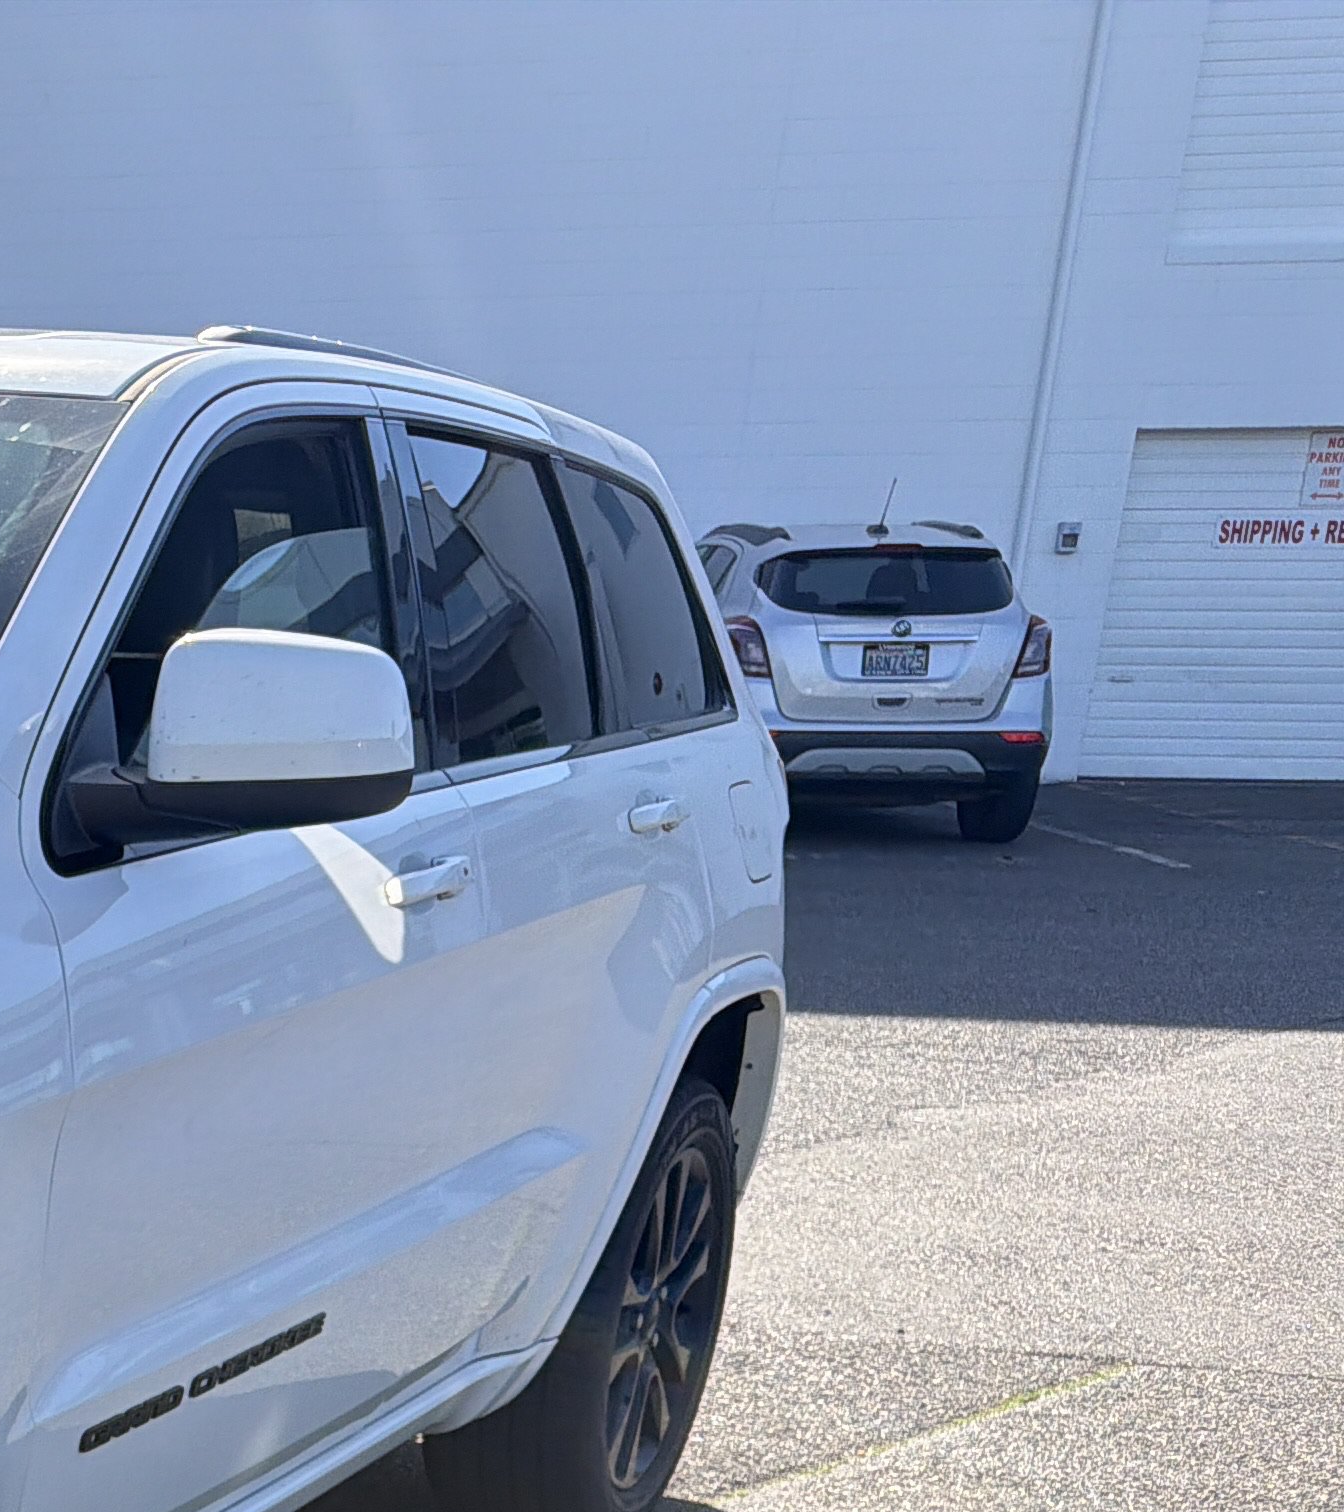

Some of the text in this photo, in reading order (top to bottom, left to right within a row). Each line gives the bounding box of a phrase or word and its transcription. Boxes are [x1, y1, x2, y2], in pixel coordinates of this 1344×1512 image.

[1327, 437, 1344, 449] NO
[1309, 451, 1344, 464] PARKI
[1321, 466, 1342, 477] ANY
[1318, 478, 1341, 489] TIME
[1218, 519, 1305, 544] SHIPPING
